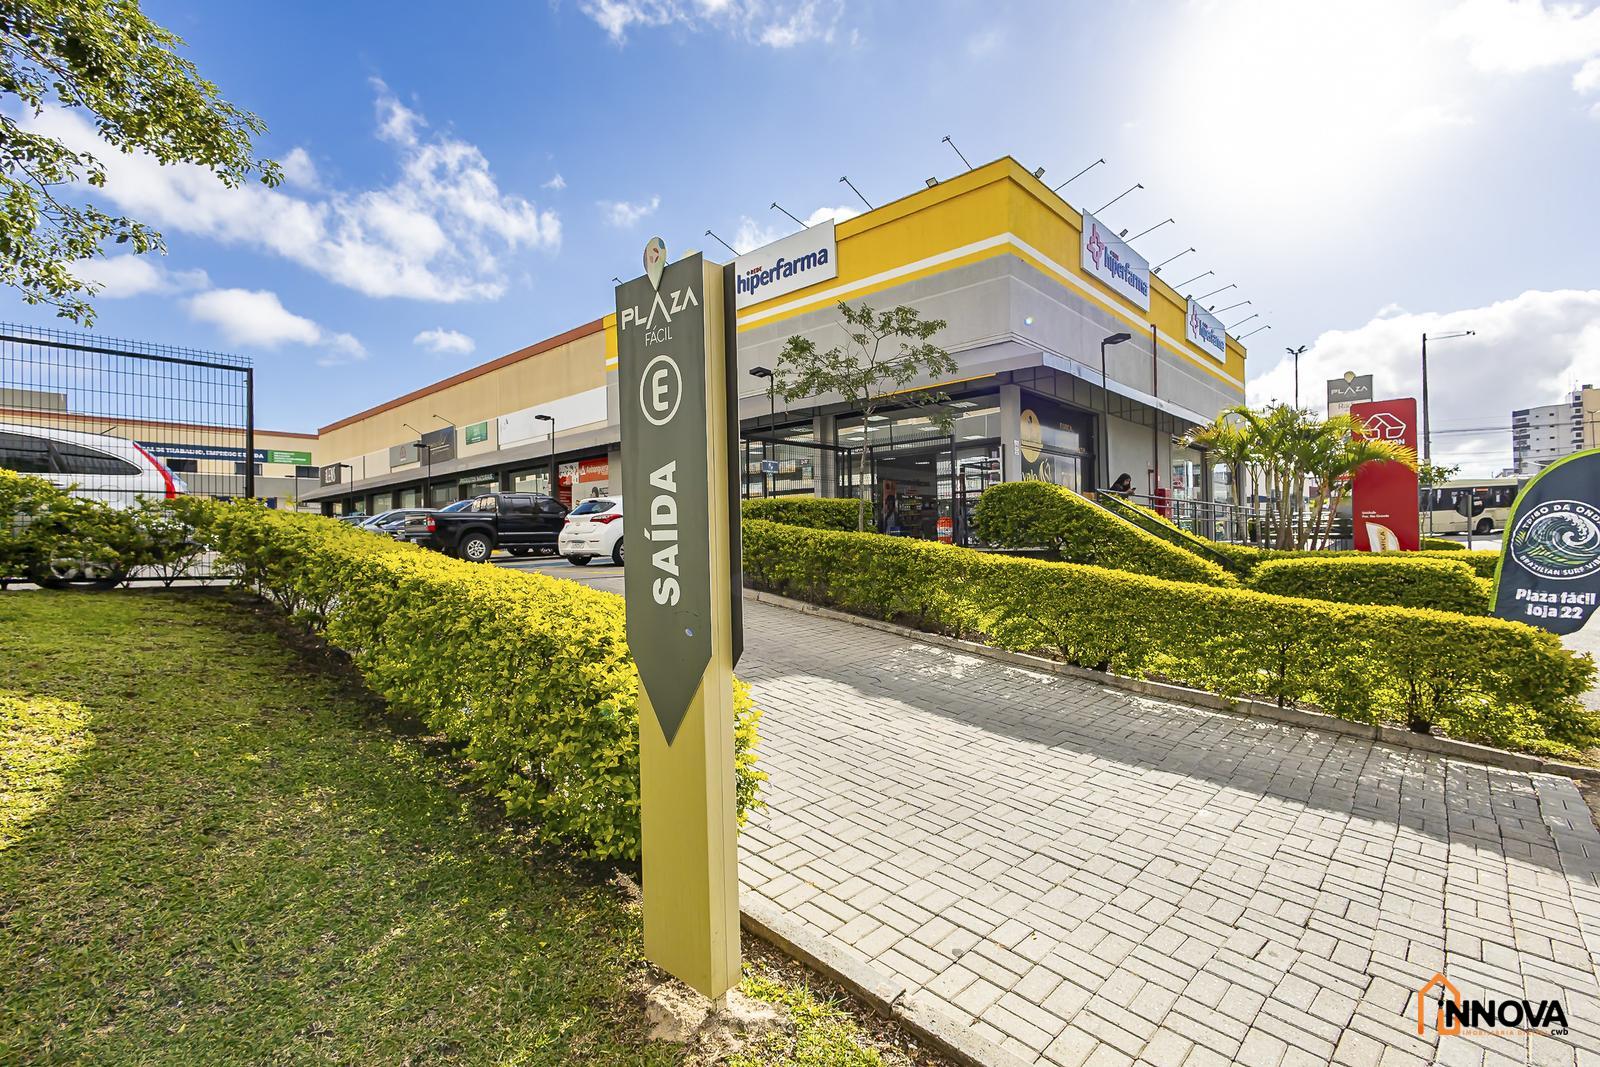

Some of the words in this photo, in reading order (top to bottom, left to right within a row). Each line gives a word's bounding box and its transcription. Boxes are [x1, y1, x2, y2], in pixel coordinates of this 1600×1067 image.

[737, 247, 828, 295] hiperfarma
[1104, 246, 1148, 296] hiperfarma
[621, 286, 698, 330] PLAZA
[645, 325, 672, 347] FÁCIL
[652, 368, 669, 412] E
[1331, 385, 1368, 395] PLAZA
[1522, 506, 1549, 529] TRIBO
[1553, 503, 1571, 512] DA
[644, 460, 681, 607] SAÍDA
[1519, 555, 1560, 576] BRAZILIAN
[1563, 567, 1585, 576] SURF
[1515, 588, 1557, 604] Plaza
[1560, 591, 1597, 606] fácil
[1525, 603, 1558, 619] loja
[1560, 606, 1584, 620] 22
